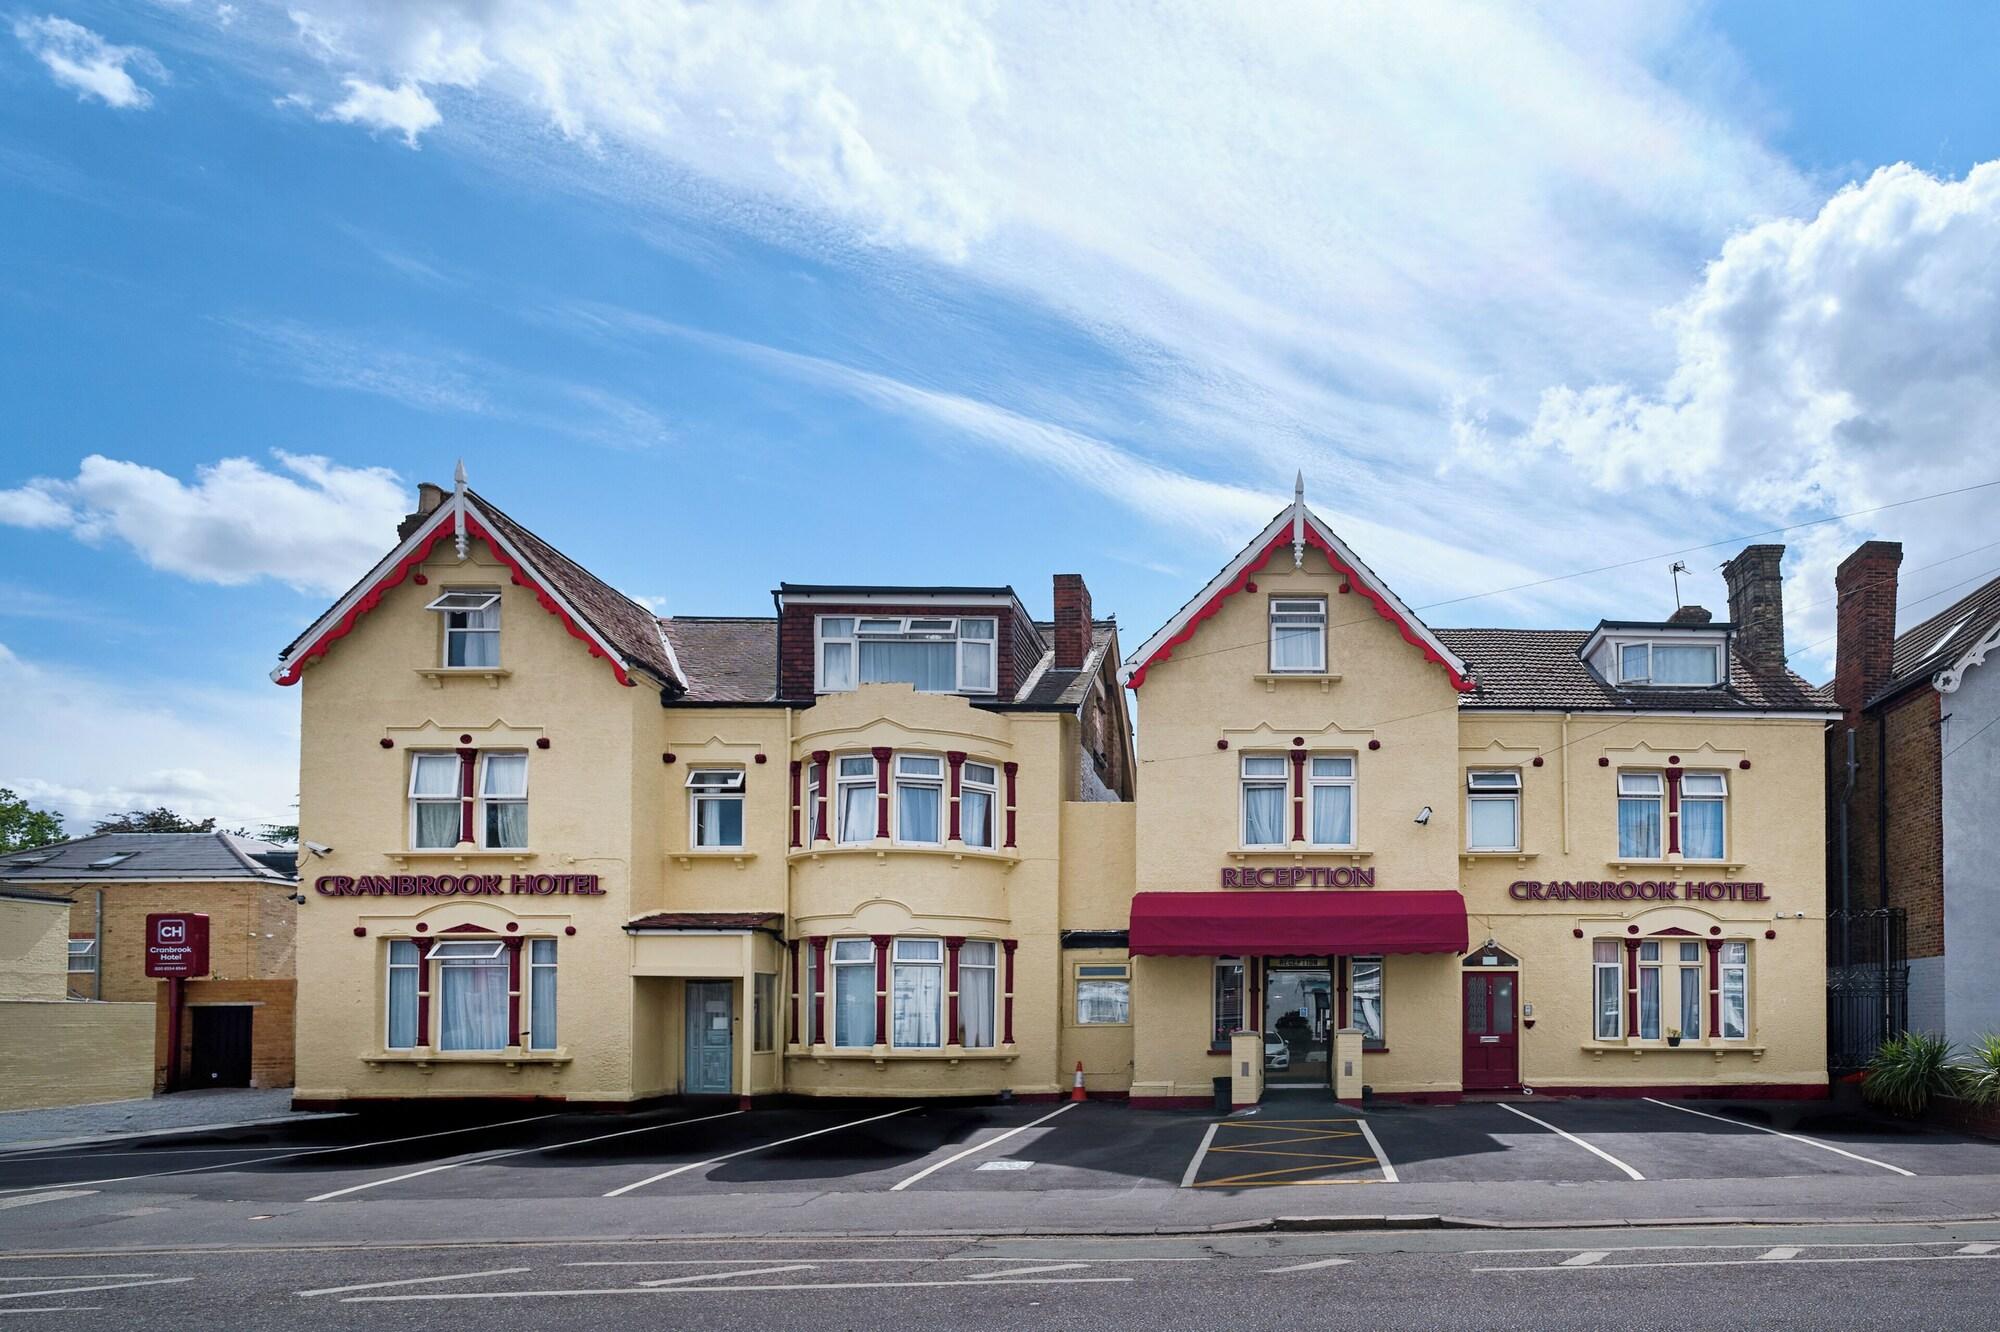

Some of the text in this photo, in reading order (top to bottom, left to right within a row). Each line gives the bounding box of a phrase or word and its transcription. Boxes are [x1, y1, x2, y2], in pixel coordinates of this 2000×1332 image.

[315, 874, 607, 896] CRANBROOK HOTEL
[1222, 867, 1375, 888] RECEPTION
[1509, 880, 1771, 902] CRANBROOK HOTEL
[161, 926, 182, 937] CH
